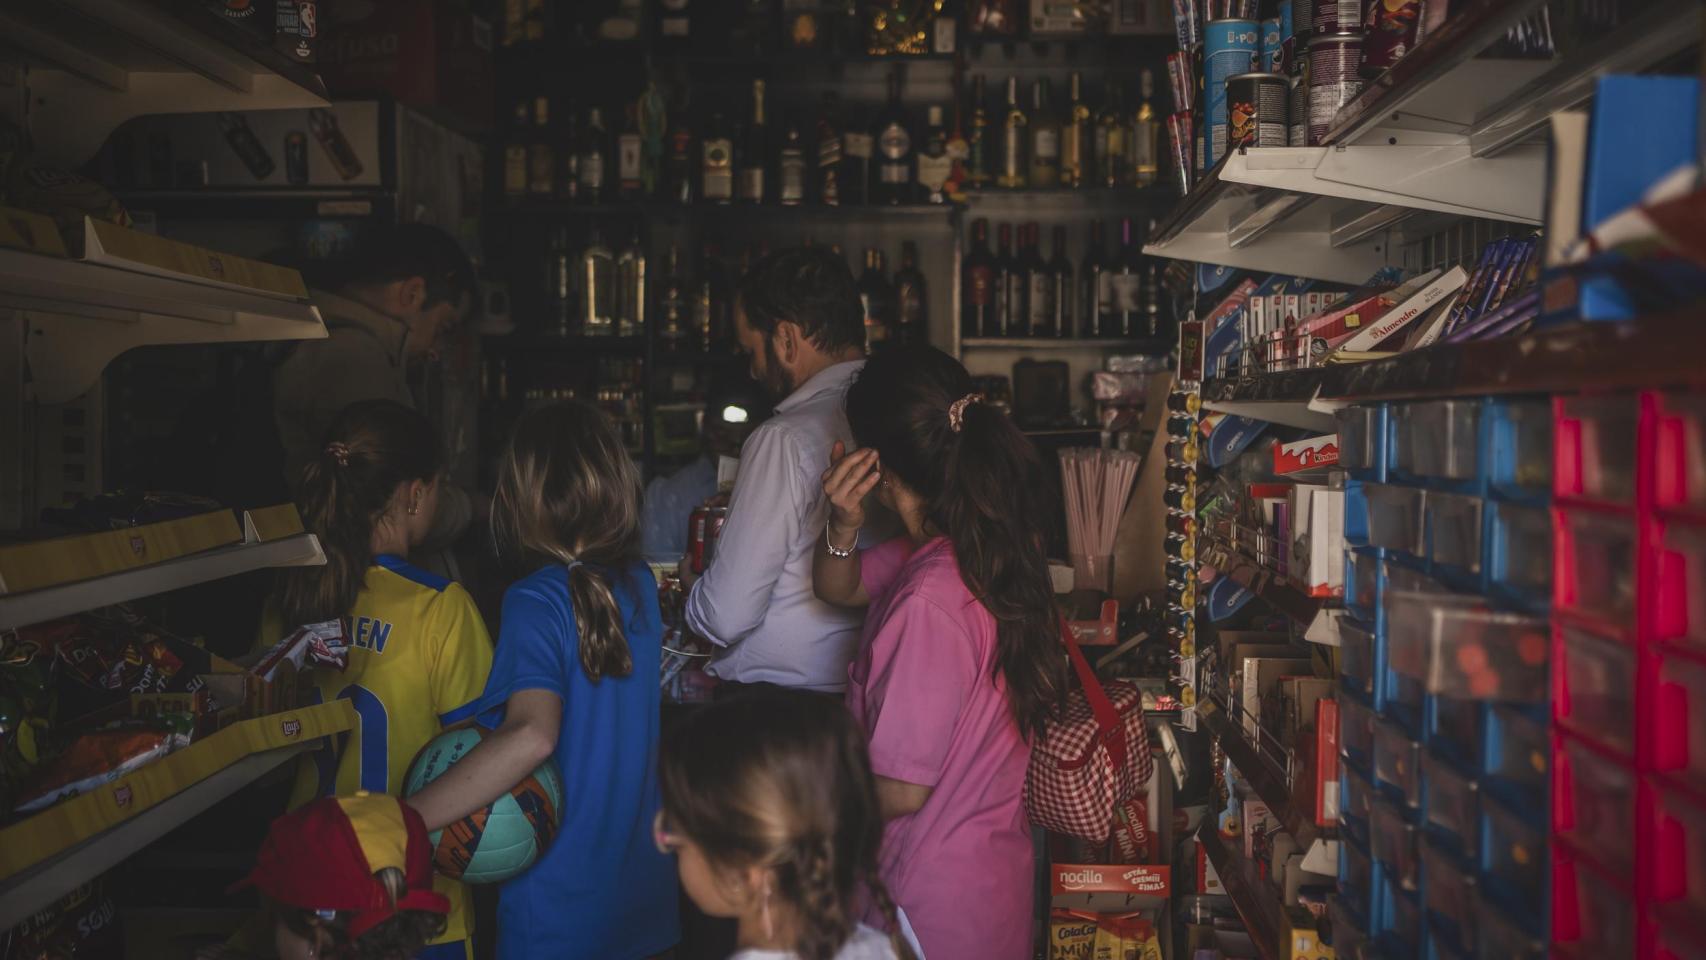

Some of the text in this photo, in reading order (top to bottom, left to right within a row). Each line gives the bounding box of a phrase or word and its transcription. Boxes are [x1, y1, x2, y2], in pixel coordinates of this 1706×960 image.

[1378, 308, 1418, 337] Almendro
[1125, 805, 1145, 839] nocilla
[1060, 870, 1102, 884] nocilla
